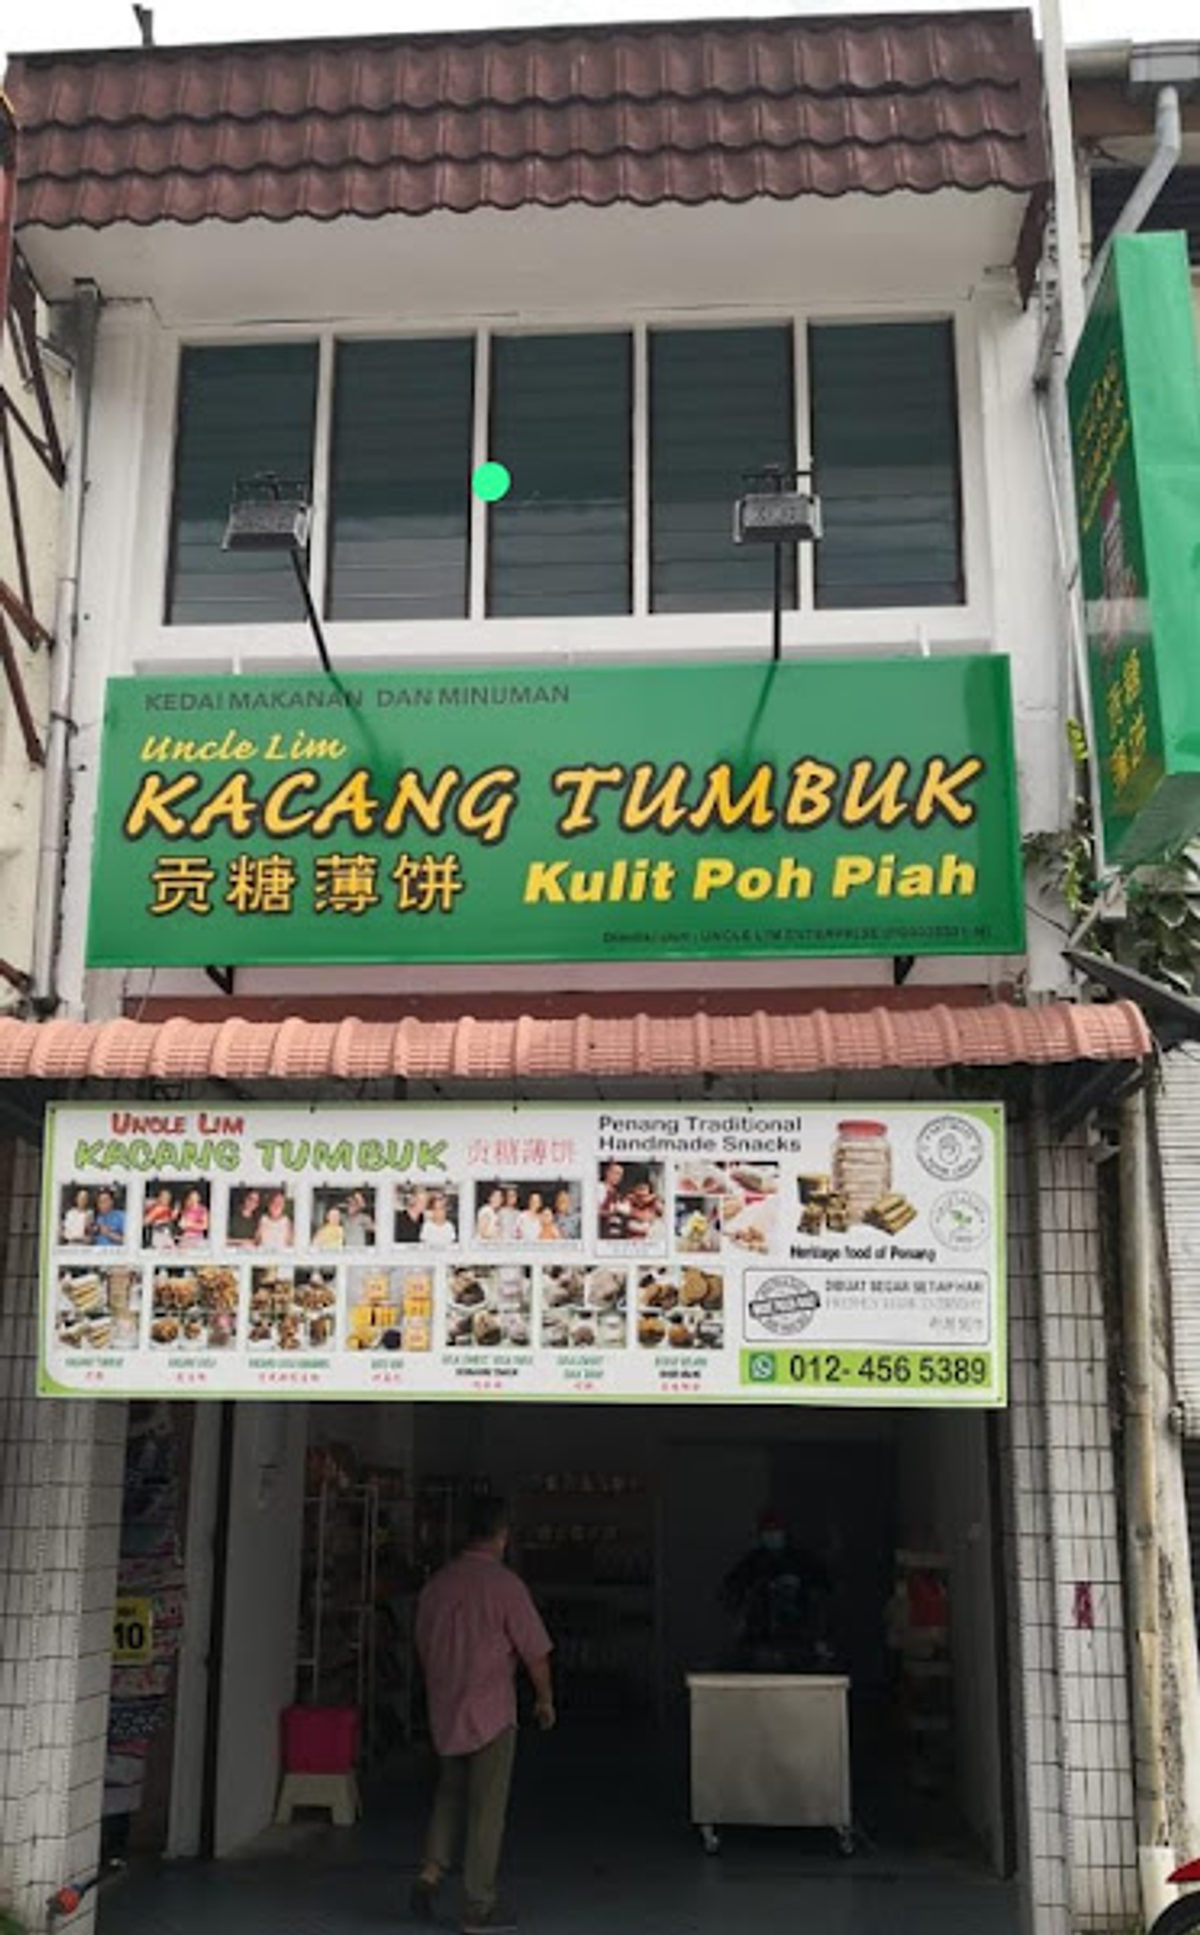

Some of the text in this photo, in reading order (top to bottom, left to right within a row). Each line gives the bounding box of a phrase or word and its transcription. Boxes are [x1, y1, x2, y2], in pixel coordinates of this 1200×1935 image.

[145, 685, 569, 712] KEDAI MAKANAN DAN MINUMAN
[141, 728, 347, 763] Uncle Lim
[124, 755, 985, 842] KACANG TUMBUK
[147, 852, 465, 918] 贡糖薄饼
[523, 854, 977, 904] Kulit Poh Piah
[111, 1112, 245, 1136] UNCLE LIM
[599, 1115, 803, 1136] Penang Traditional
[74, 1138, 448, 1172] KACANG TUMBUK
[599, 1135, 803, 1152] Handmade Snacks
[858, 1356, 911, 1383] 456
[919, 1357, 986, 1384] 5389
[114, 1622, 144, 1650] 10
